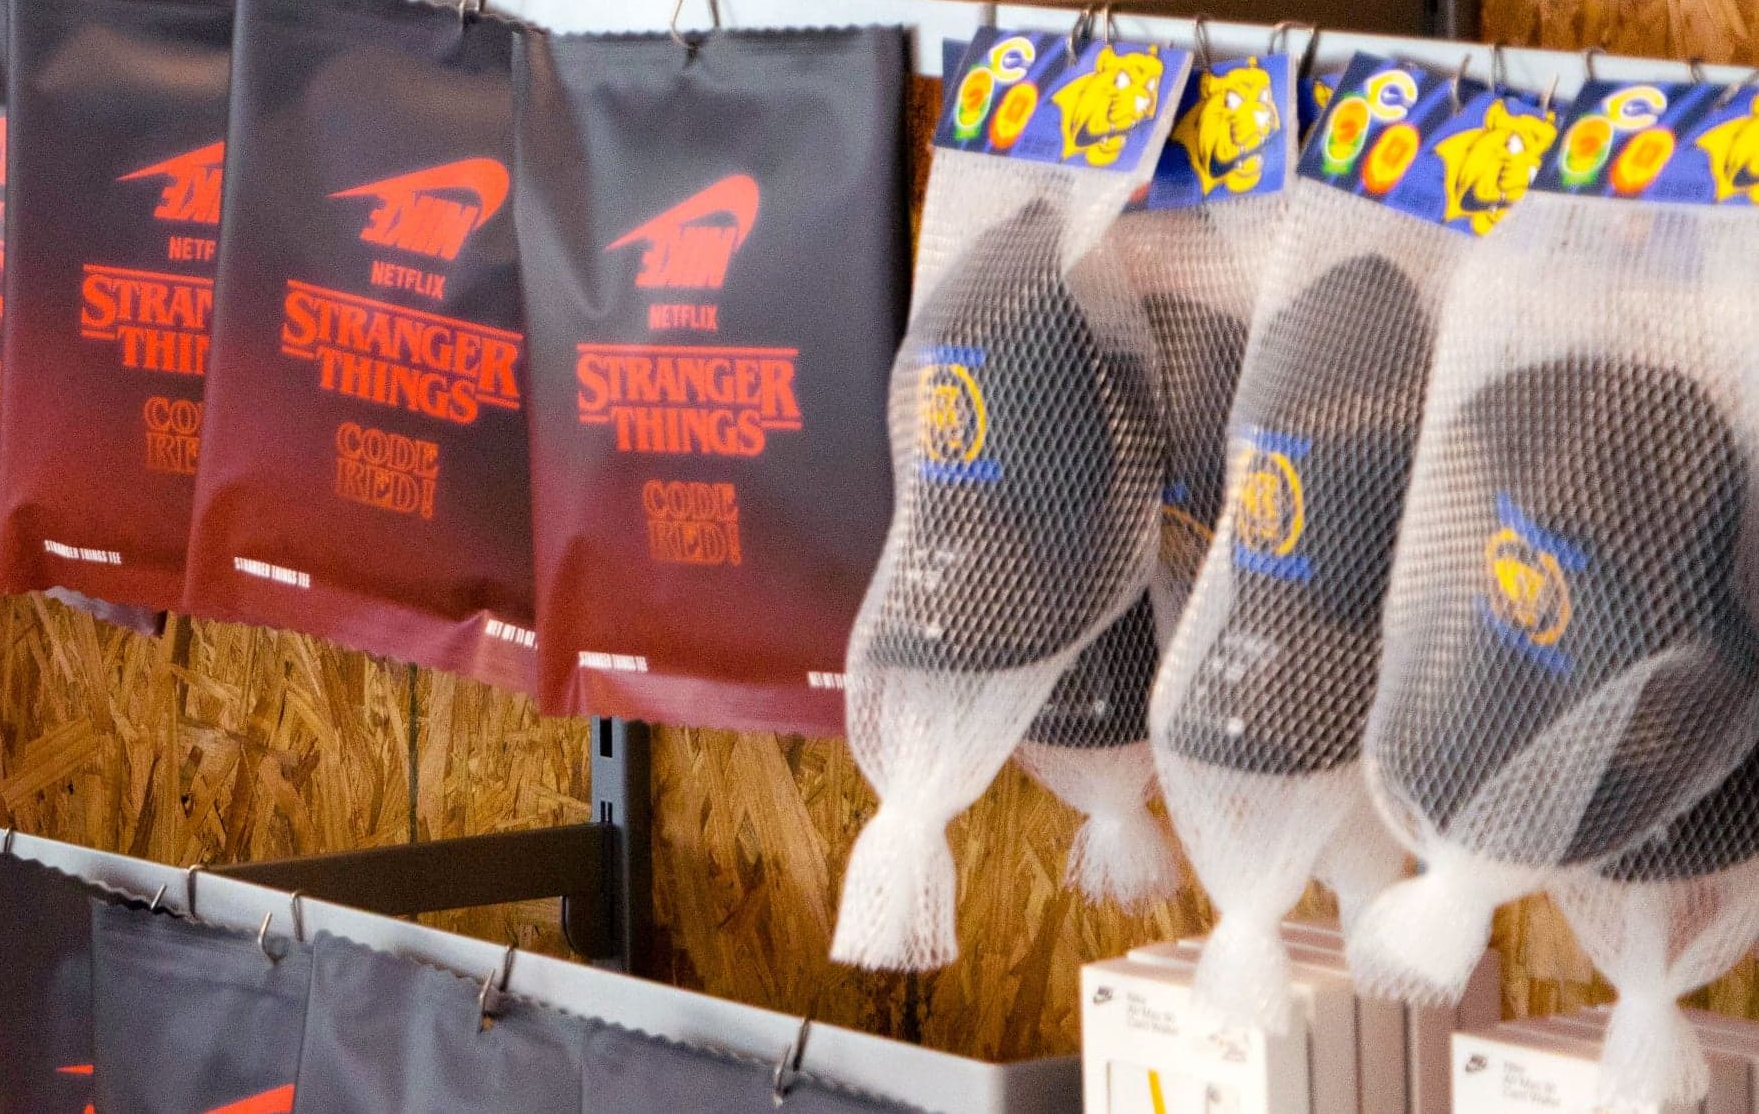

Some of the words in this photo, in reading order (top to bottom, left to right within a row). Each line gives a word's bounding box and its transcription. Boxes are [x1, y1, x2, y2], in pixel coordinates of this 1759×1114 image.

[168, 237, 214, 261] NETF
[371, 261, 445, 300] NETFLIX
[282, 289, 519, 396] STRANGER
[648, 304, 719, 333] NETFLIX
[313, 348, 480, 425] THINGS
[577, 353, 801, 420] STRANGER
[339, 422, 438, 473] CODE
[612, 407, 766, 457] THINGS
